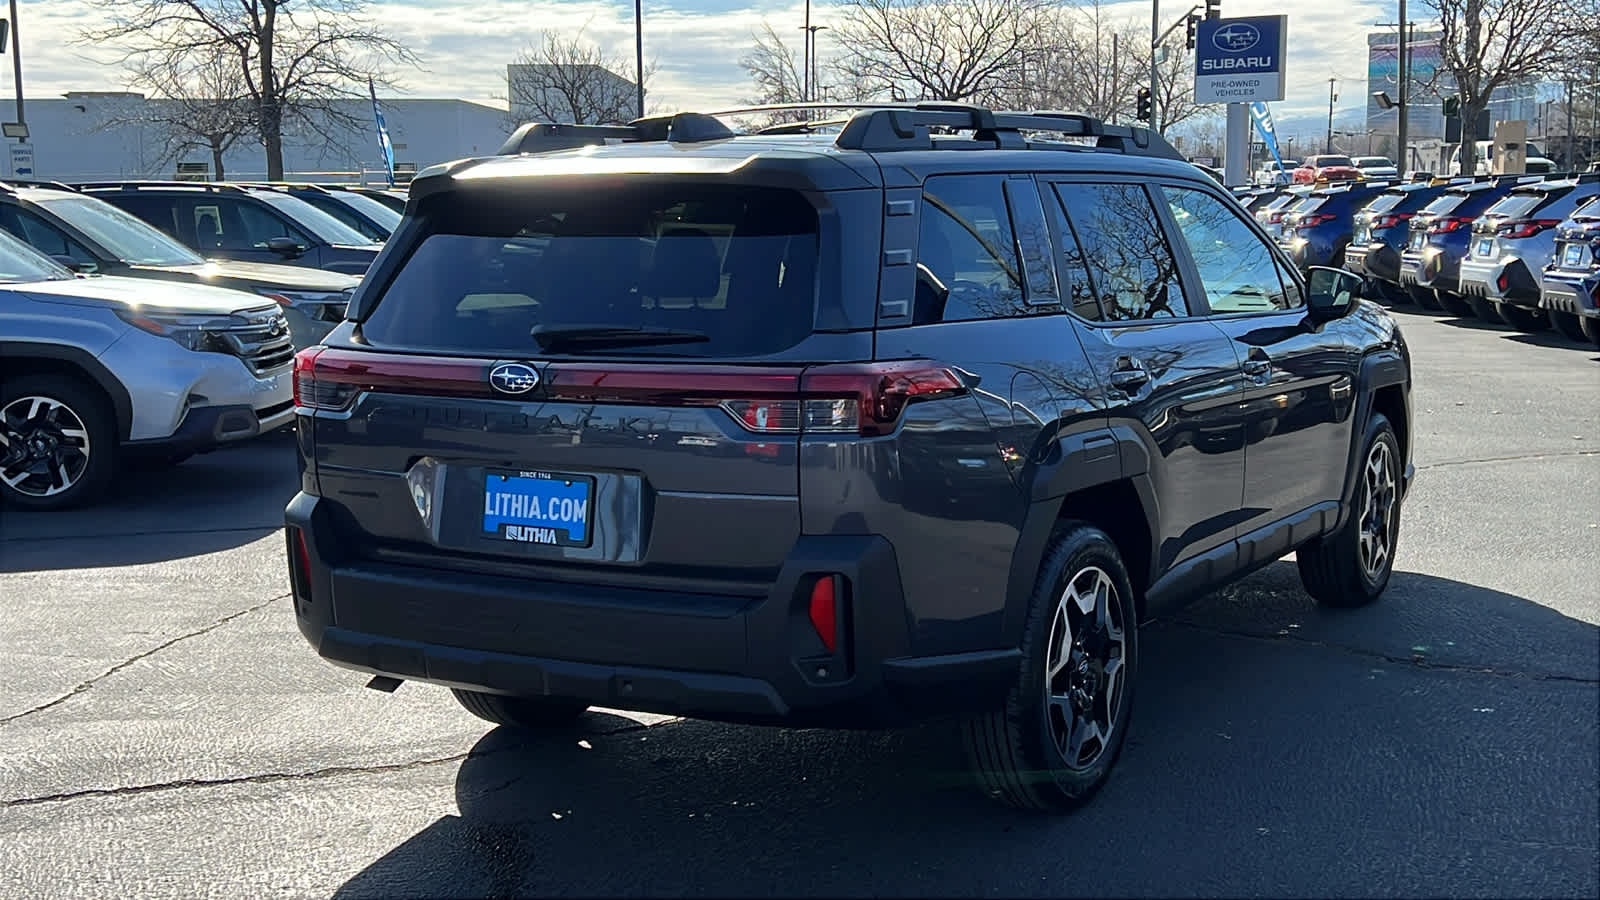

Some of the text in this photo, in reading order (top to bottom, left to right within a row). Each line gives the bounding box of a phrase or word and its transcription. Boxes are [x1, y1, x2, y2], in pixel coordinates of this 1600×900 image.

[1202, 56, 1272, 70] SUBARU
[1211, 79, 1260, 89] PRE-OWNED
[1215, 88, 1255, 97] VEHICLES
[519, 471, 537, 479] SINCE
[484, 491, 588, 524] LITHIA.COM
[517, 526, 558, 545] LITHIA
